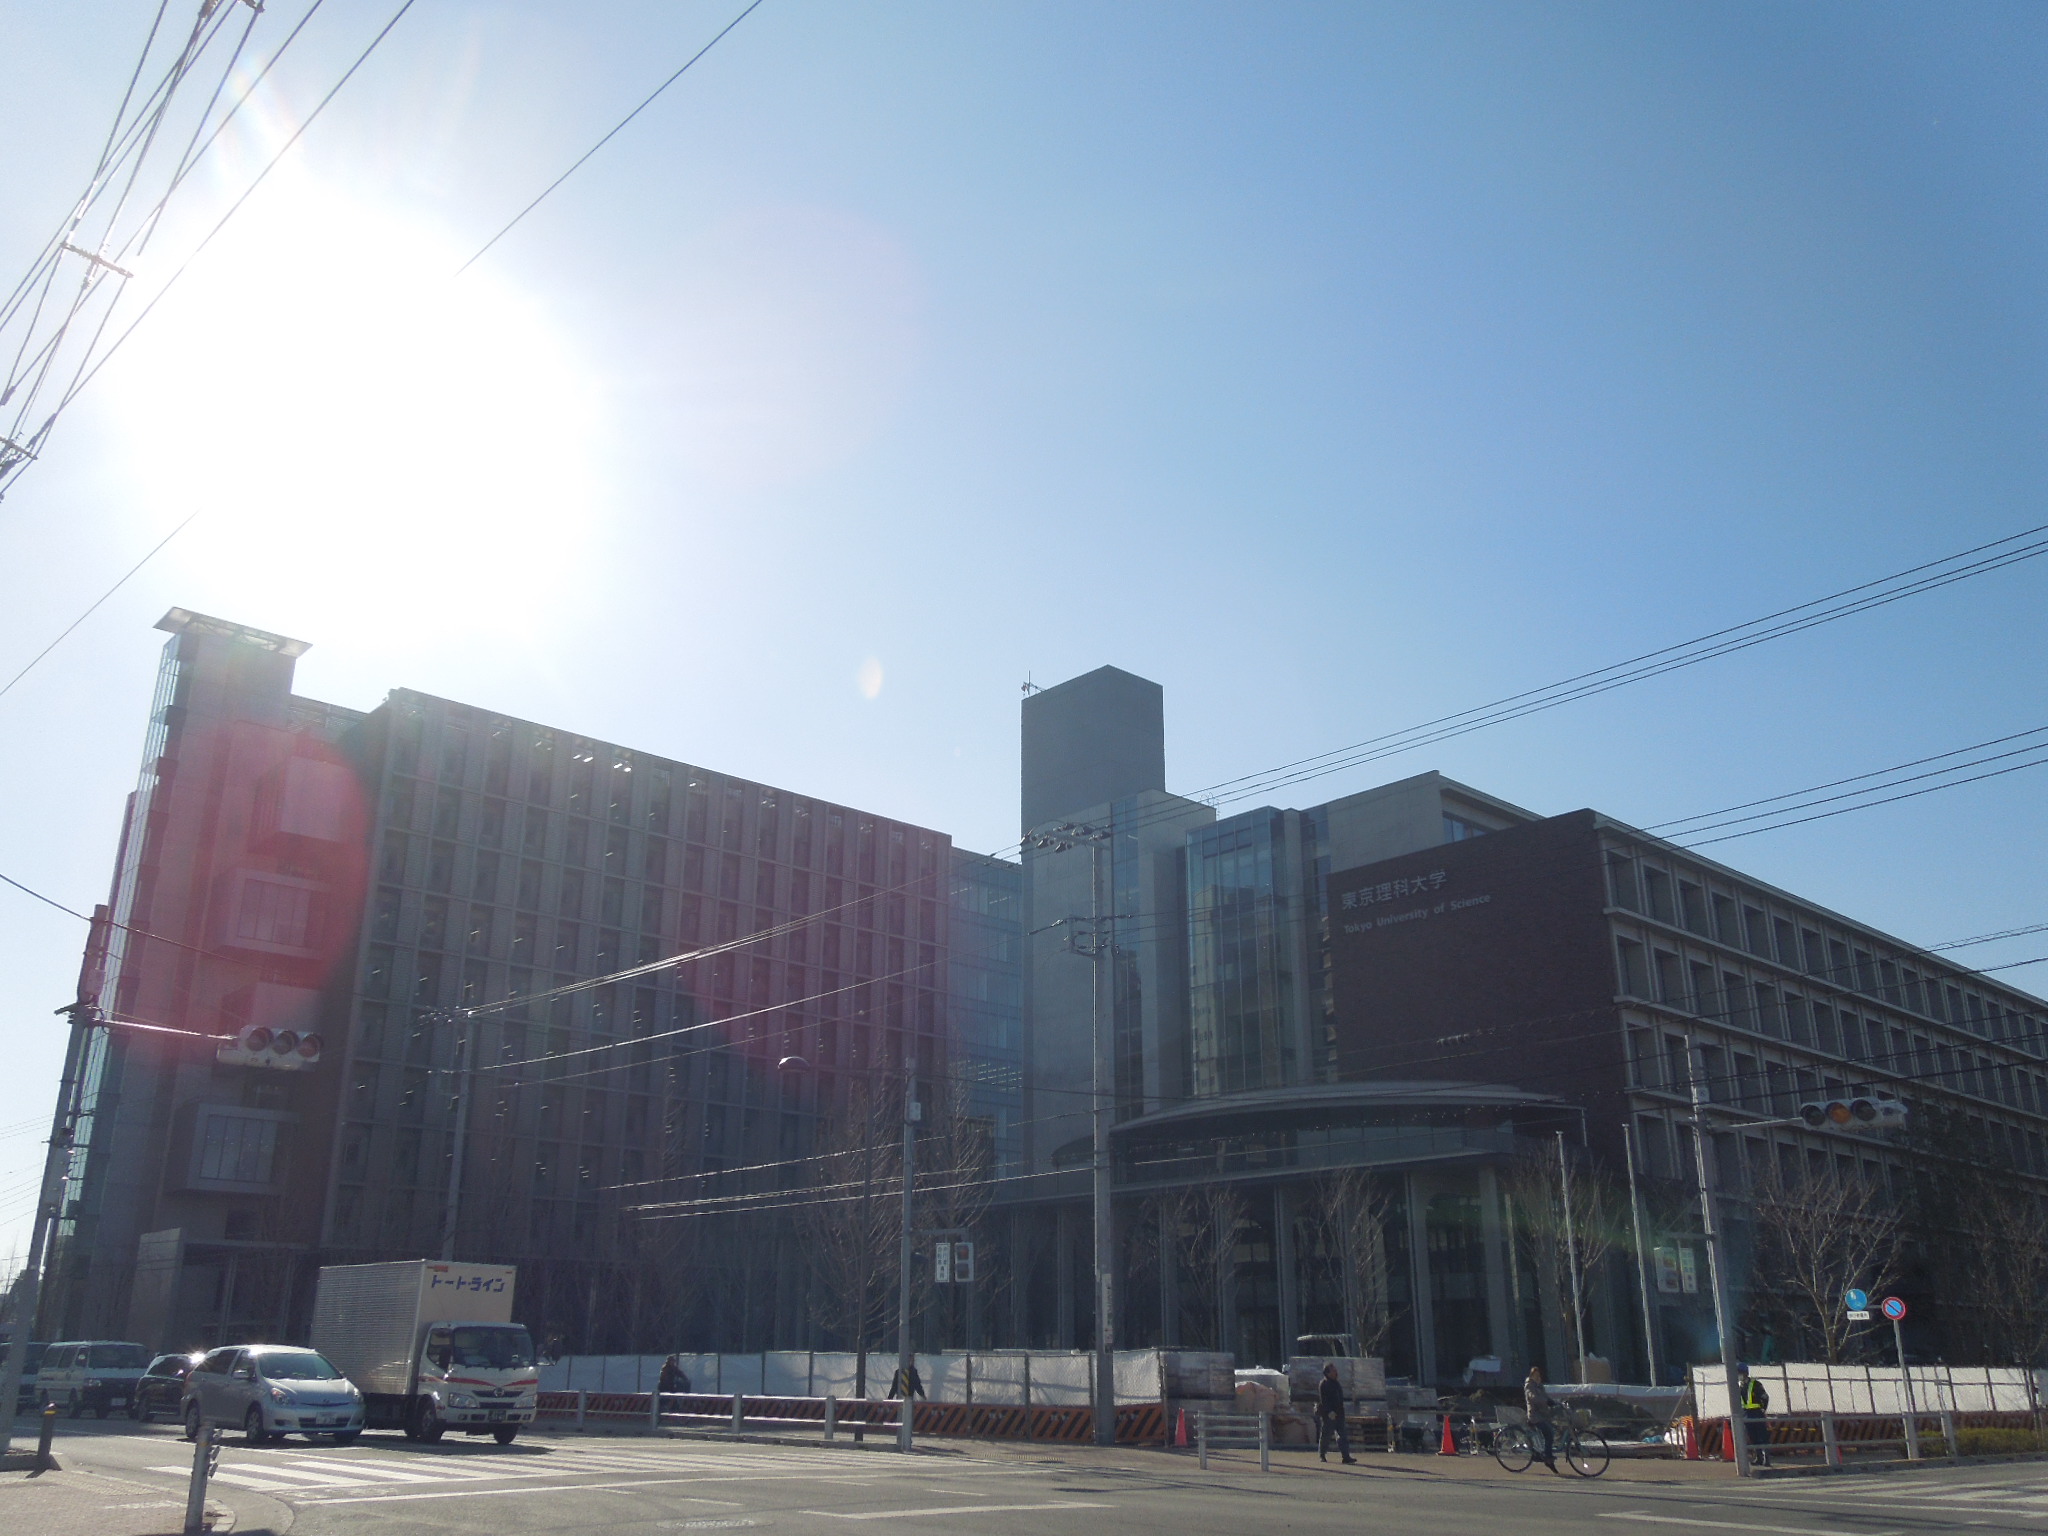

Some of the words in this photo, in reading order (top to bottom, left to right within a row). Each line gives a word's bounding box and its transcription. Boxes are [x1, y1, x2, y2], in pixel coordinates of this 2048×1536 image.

[1341, 870, 1447, 910] 東京理科大学
[1344, 921, 1373, 934] Tokyo
[1377, 908, 1429, 927] University
[1433, 901, 1445, 914] of
[1450, 894, 1491, 911] Science
